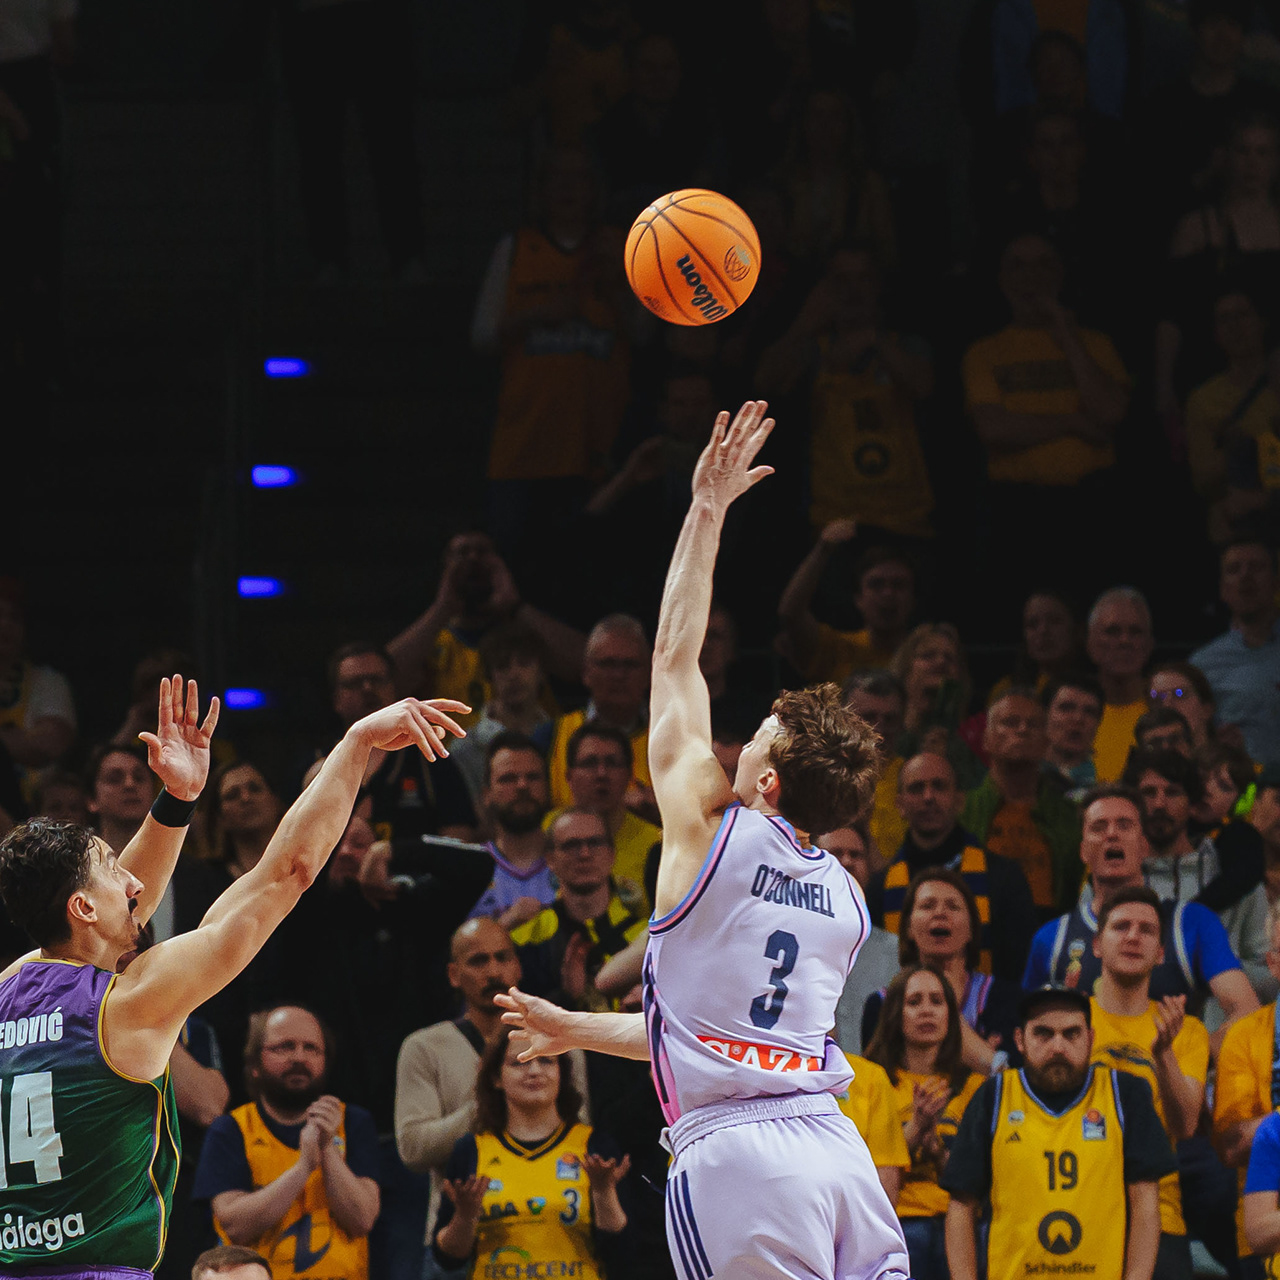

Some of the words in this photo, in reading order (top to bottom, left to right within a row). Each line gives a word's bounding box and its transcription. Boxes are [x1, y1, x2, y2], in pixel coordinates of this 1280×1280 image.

[750, 863, 836, 919] O'CONNELL
[749, 929, 799, 1030] 3
[1043, 1150, 1079, 1191] 19
[559, 1186, 578, 1226] 3
